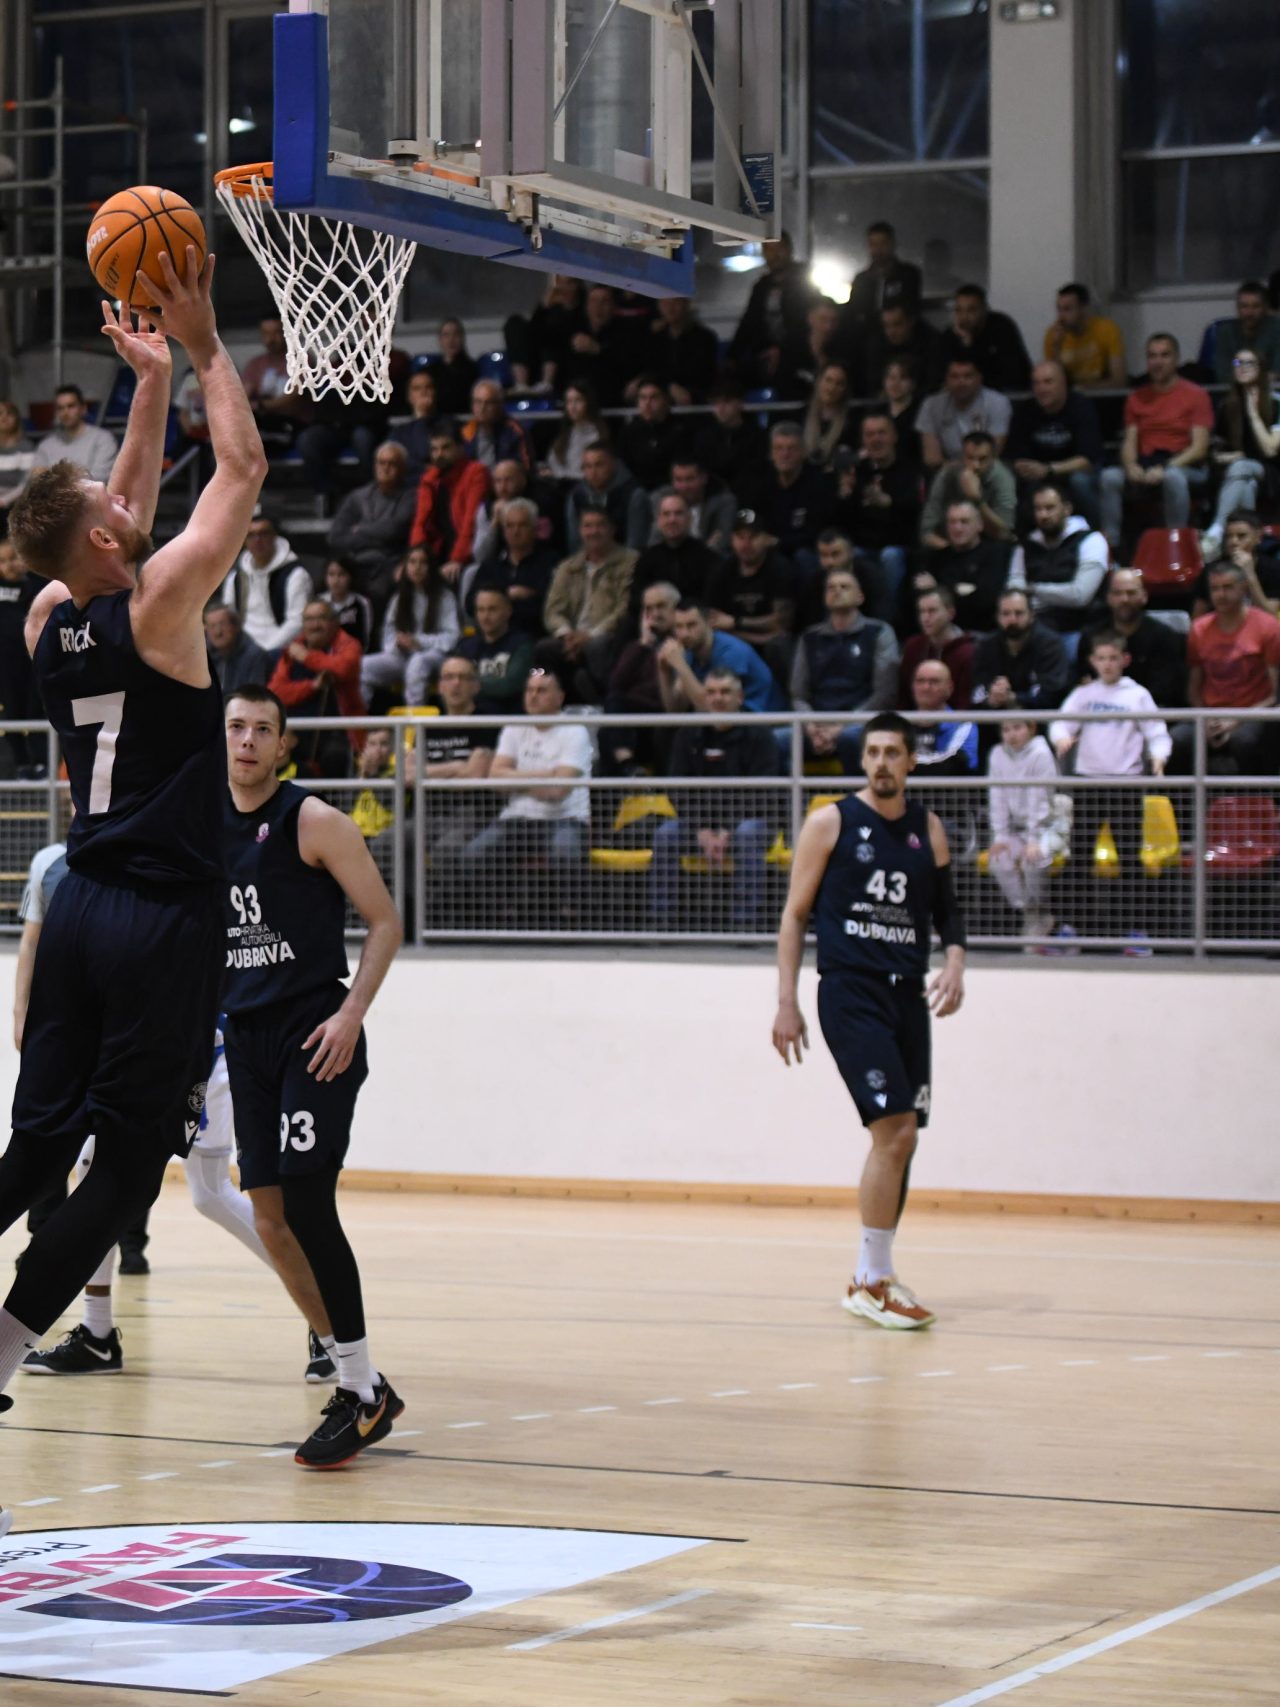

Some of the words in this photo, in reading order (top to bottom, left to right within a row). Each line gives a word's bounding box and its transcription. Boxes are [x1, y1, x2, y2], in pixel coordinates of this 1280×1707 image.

[71, 690, 126, 814] 7
[230, 884, 262, 925] 93
[865, 869, 907, 904] 43
[844, 919, 917, 945] DUBRAVA
